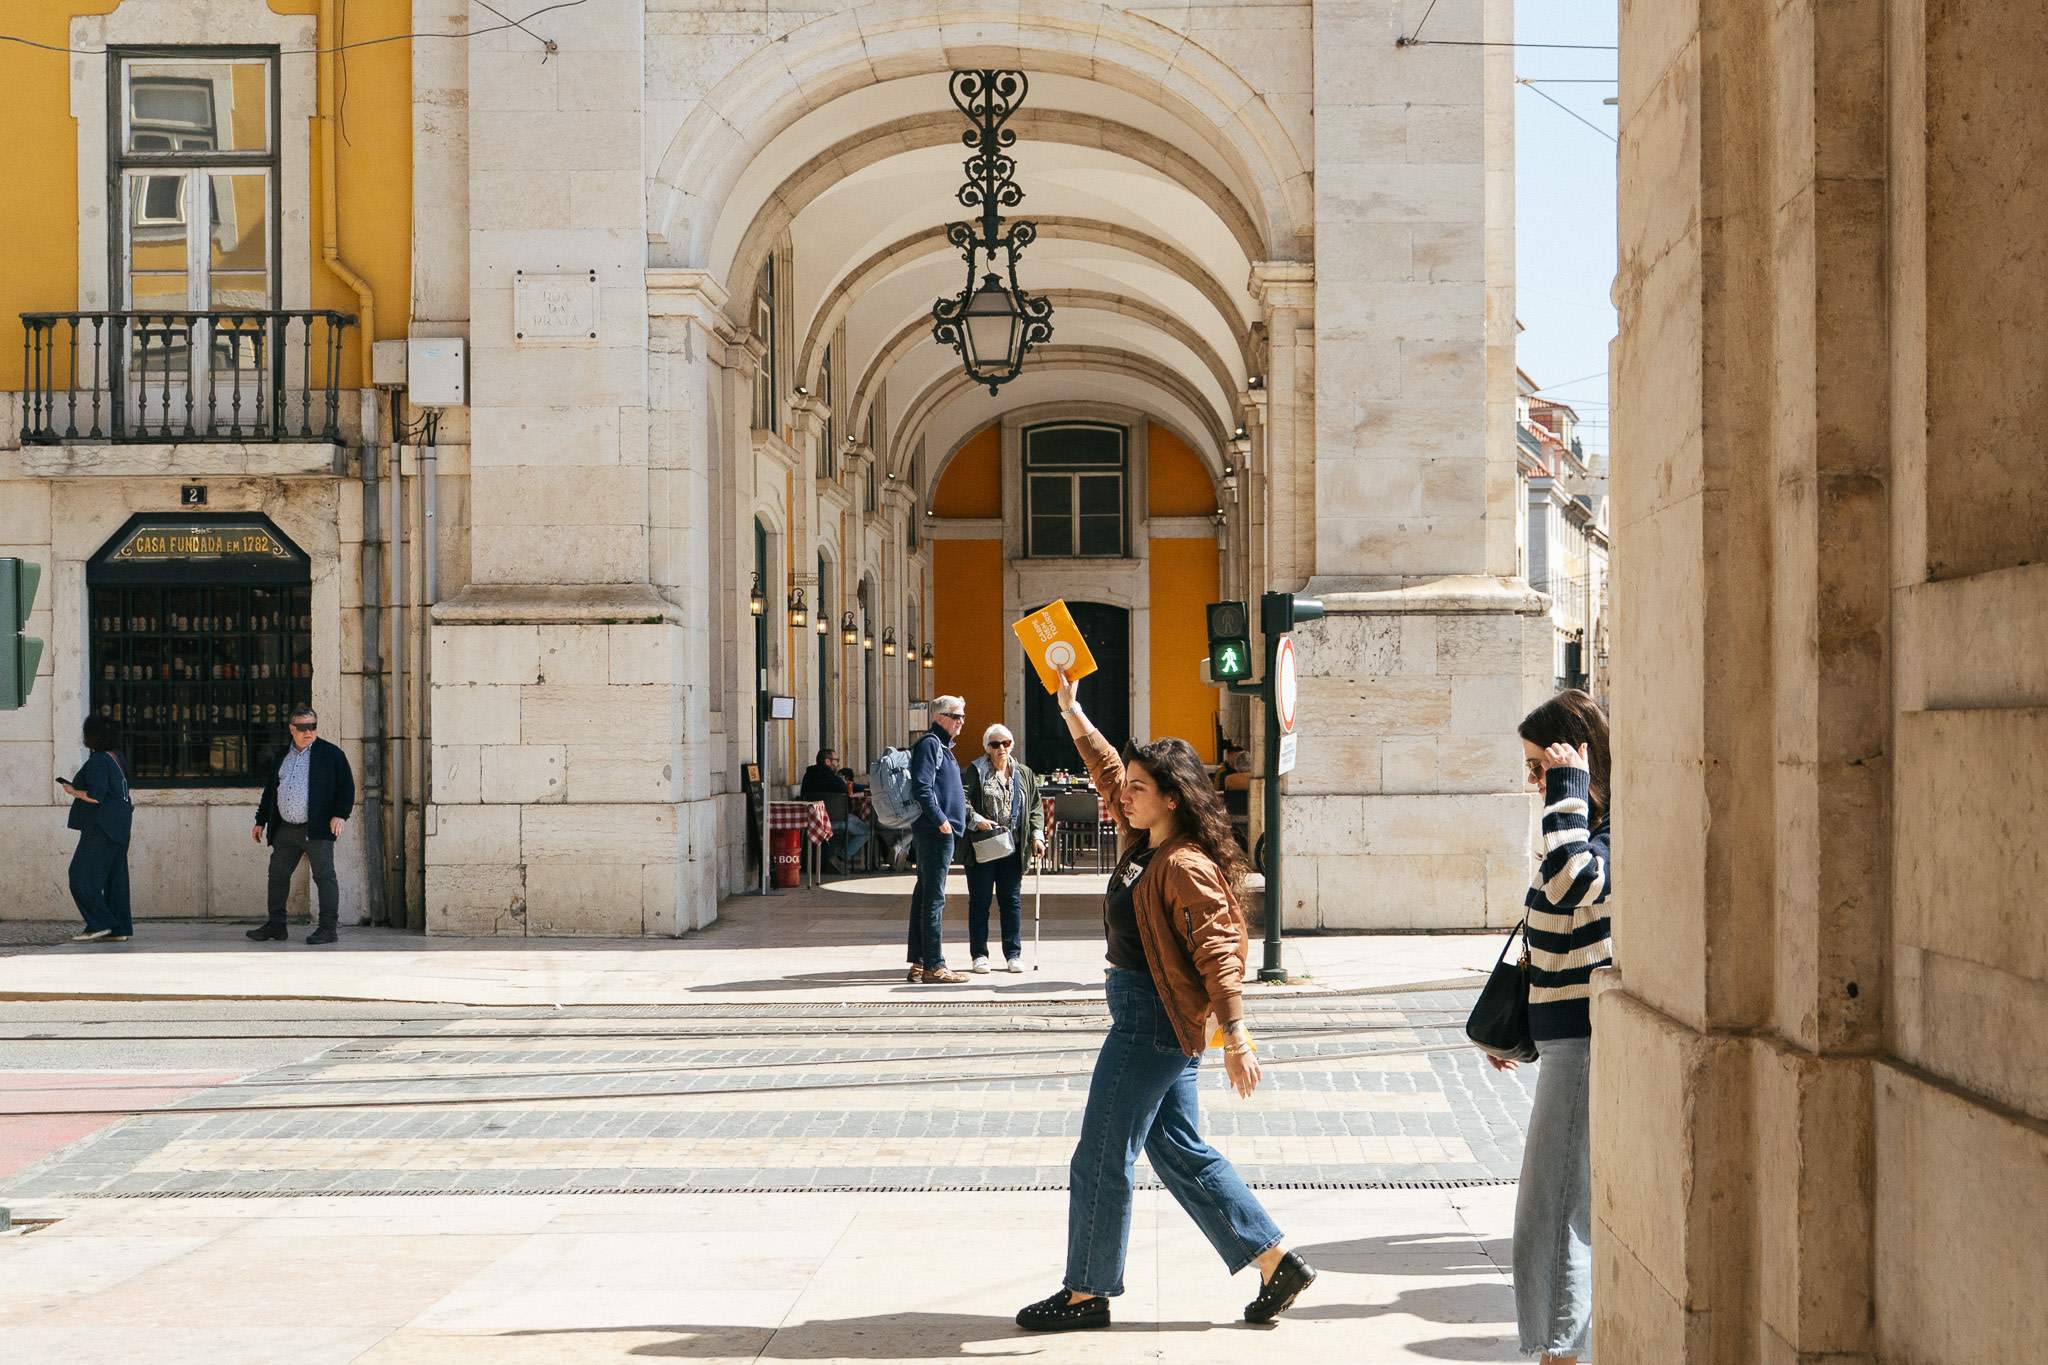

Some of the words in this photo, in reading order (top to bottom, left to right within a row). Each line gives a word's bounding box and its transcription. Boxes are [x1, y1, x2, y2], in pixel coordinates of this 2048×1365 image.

[543, 291, 570, 302] RUA
[548, 303, 566, 313] DA
[533, 315, 578, 326] PRATA
[189, 488, 198, 502] 2
[136, 536, 166, 553] CASA
[170, 536, 223, 553] FUNDADA
[226, 541, 240, 553] EM
[242, 536, 269, 552] 1782
[1031, 619, 1047, 642] CARPE
[1041, 611, 1058, 636] TOURS
[1041, 622, 1053, 640] DIEM
